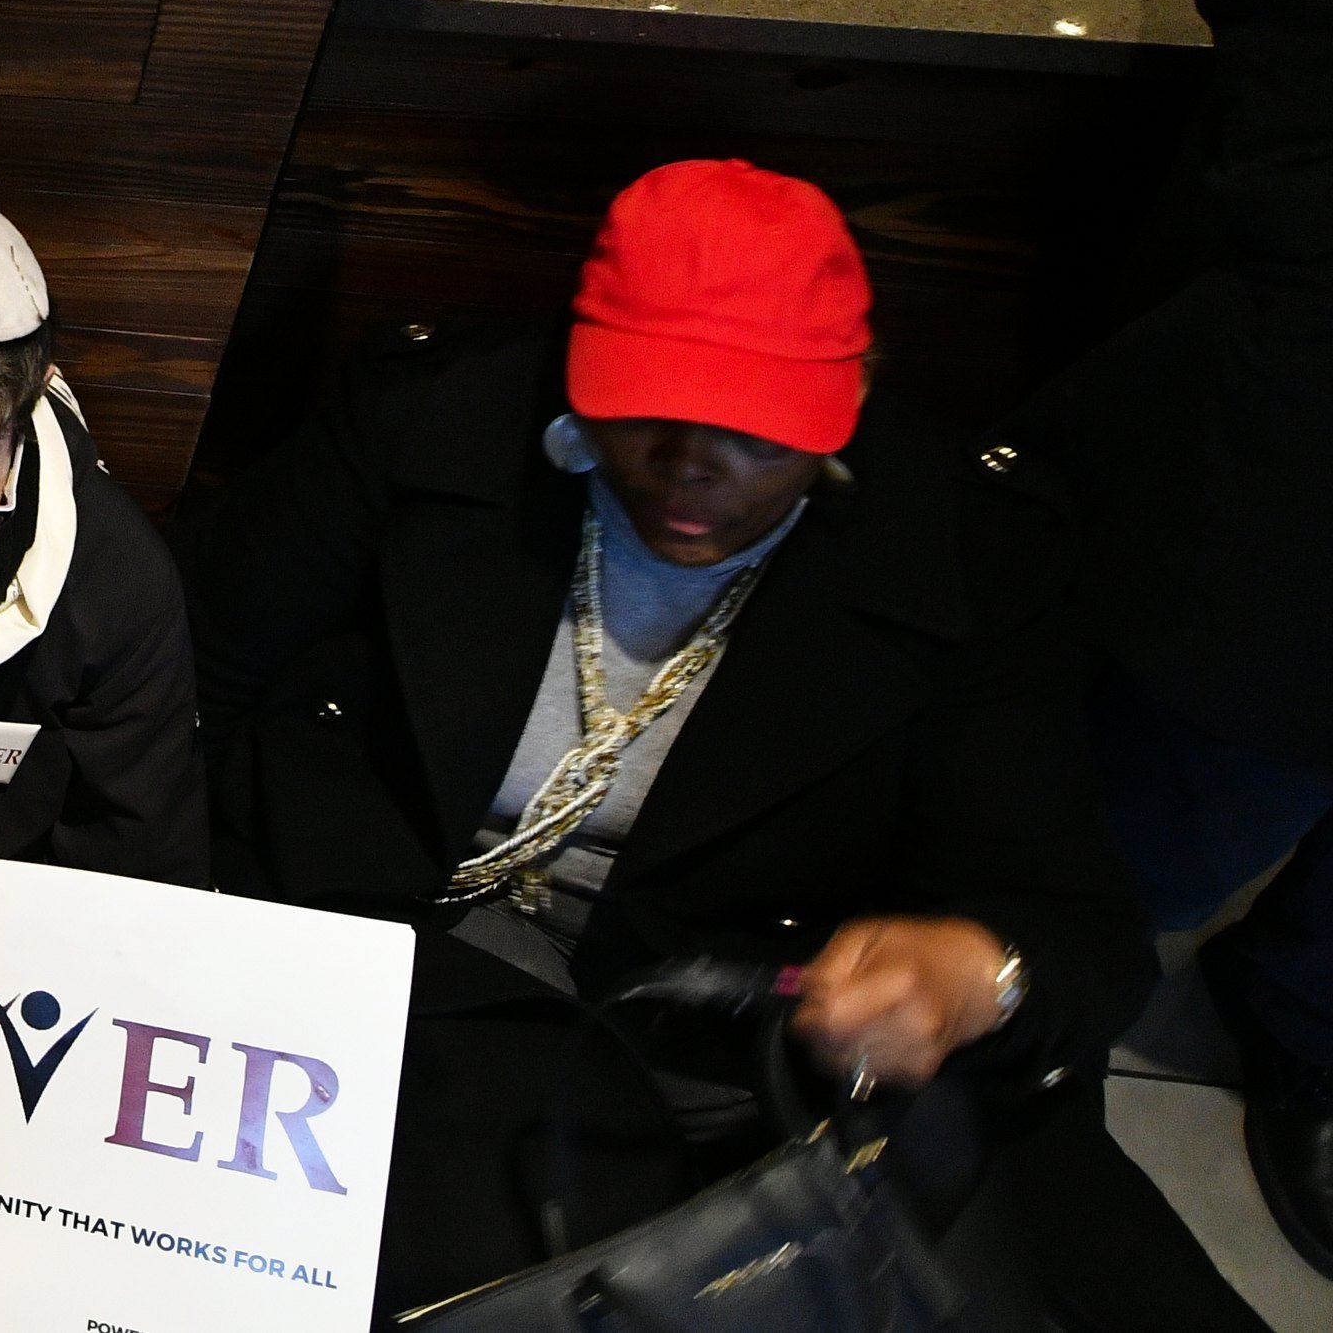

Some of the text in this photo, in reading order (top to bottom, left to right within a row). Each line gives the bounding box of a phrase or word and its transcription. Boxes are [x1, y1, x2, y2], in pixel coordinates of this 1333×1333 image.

[58, 1208, 125, 1240] THAT
[130, 1225, 228, 1265] WORKS
[233, 1250, 286, 1279] FOR
[290, 1264, 338, 1290] ALL
